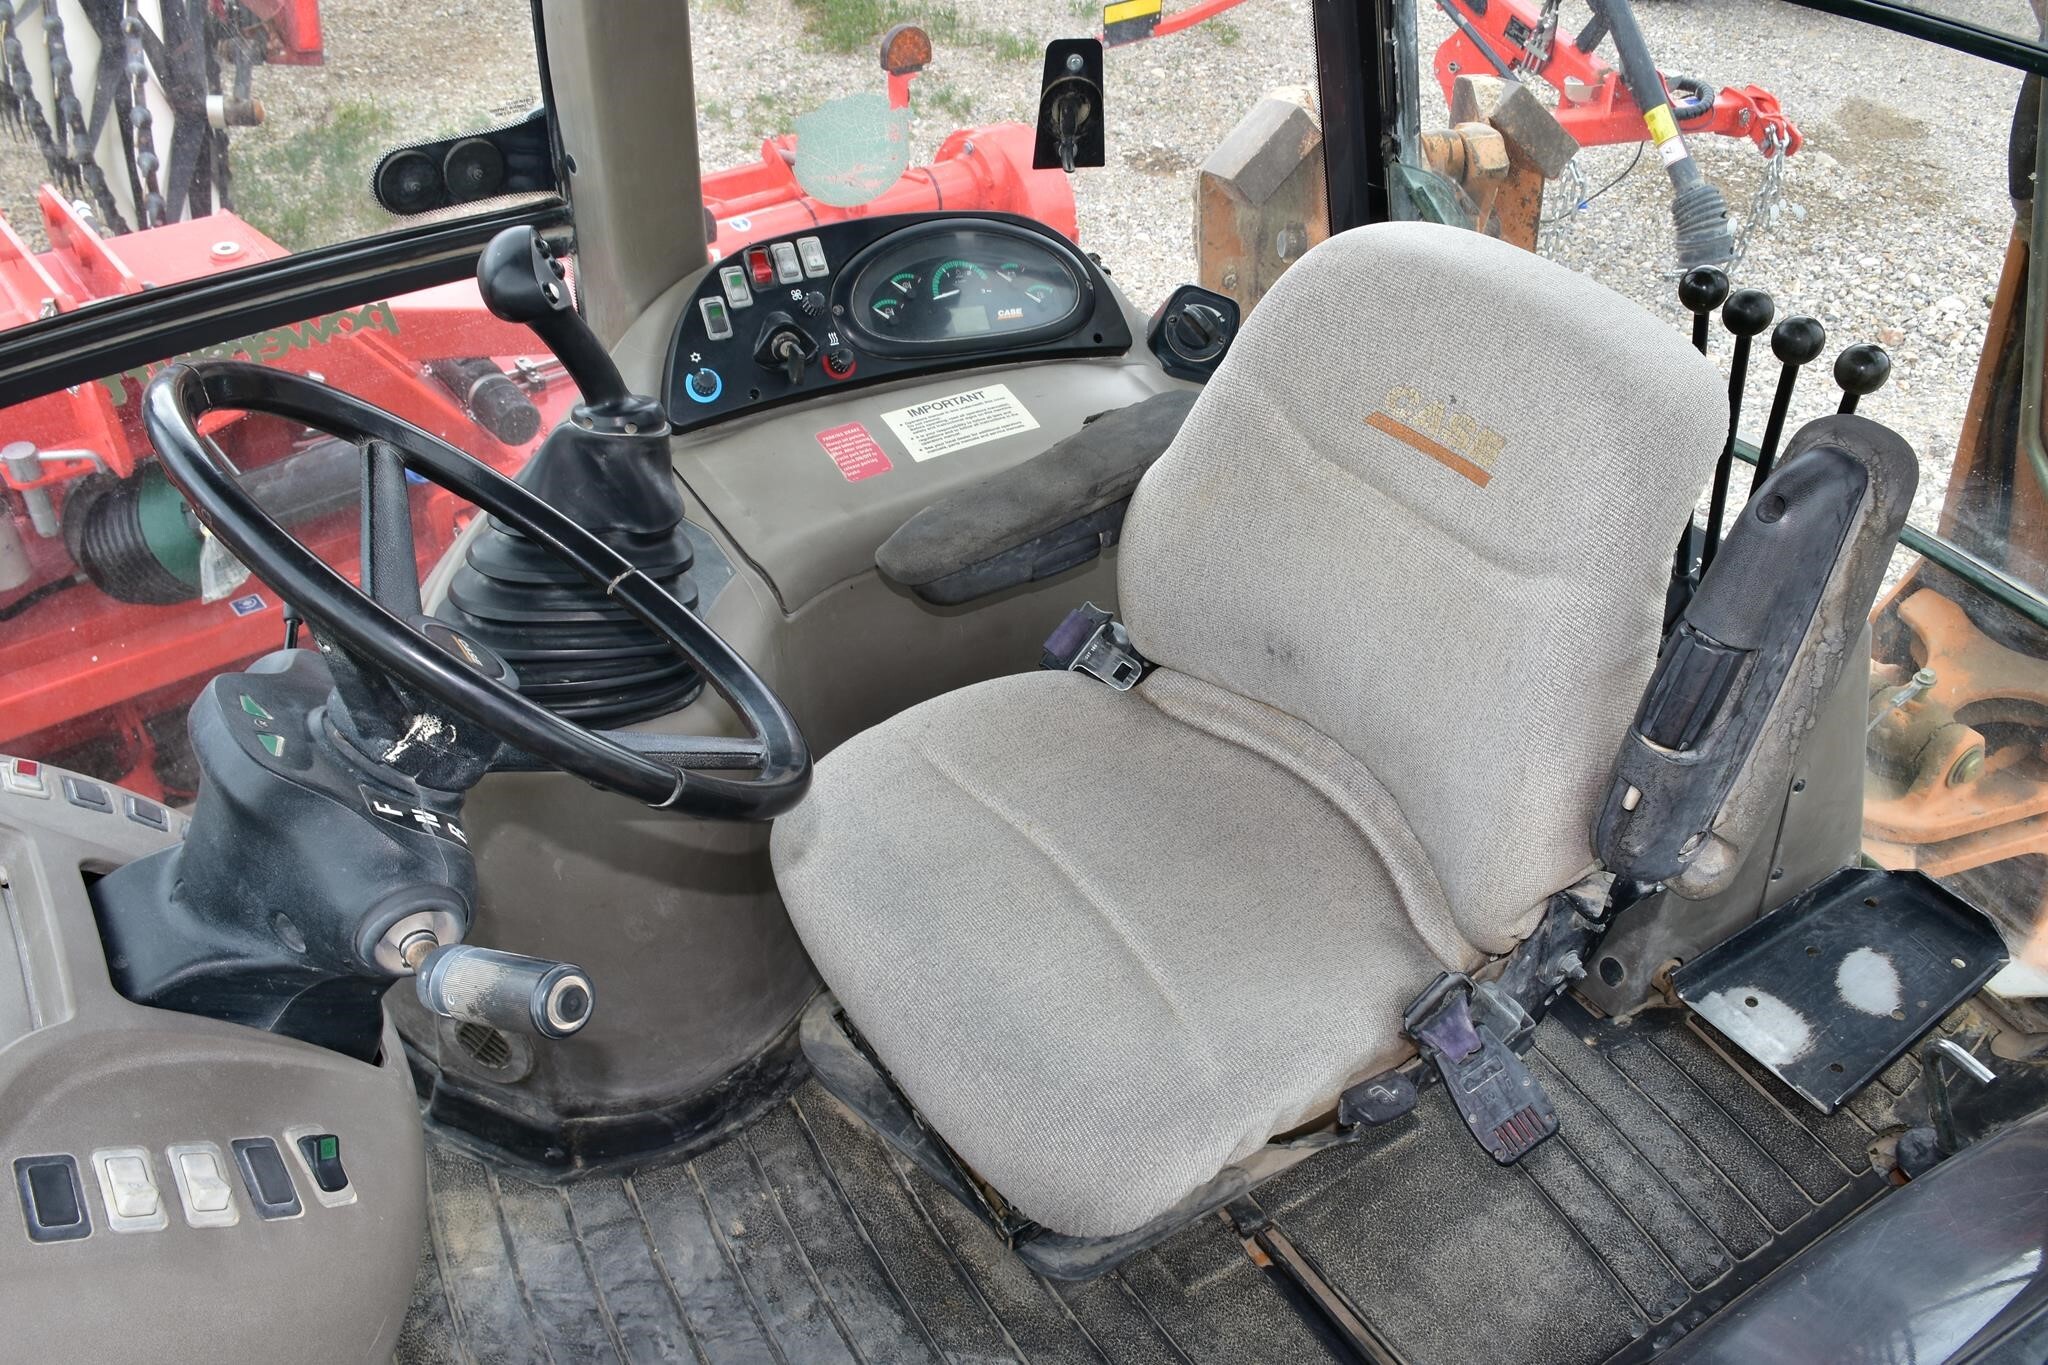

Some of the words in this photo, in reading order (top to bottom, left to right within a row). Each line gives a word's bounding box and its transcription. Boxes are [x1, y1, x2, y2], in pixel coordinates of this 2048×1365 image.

[997, 307, 1023, 318] CASE
[906, 390, 986, 417] IMPORTANT
[1385, 385, 1506, 467] CASE
[373, 801, 404, 817] F
[411, 808, 441, 829] N
[447, 822, 468, 845] R
